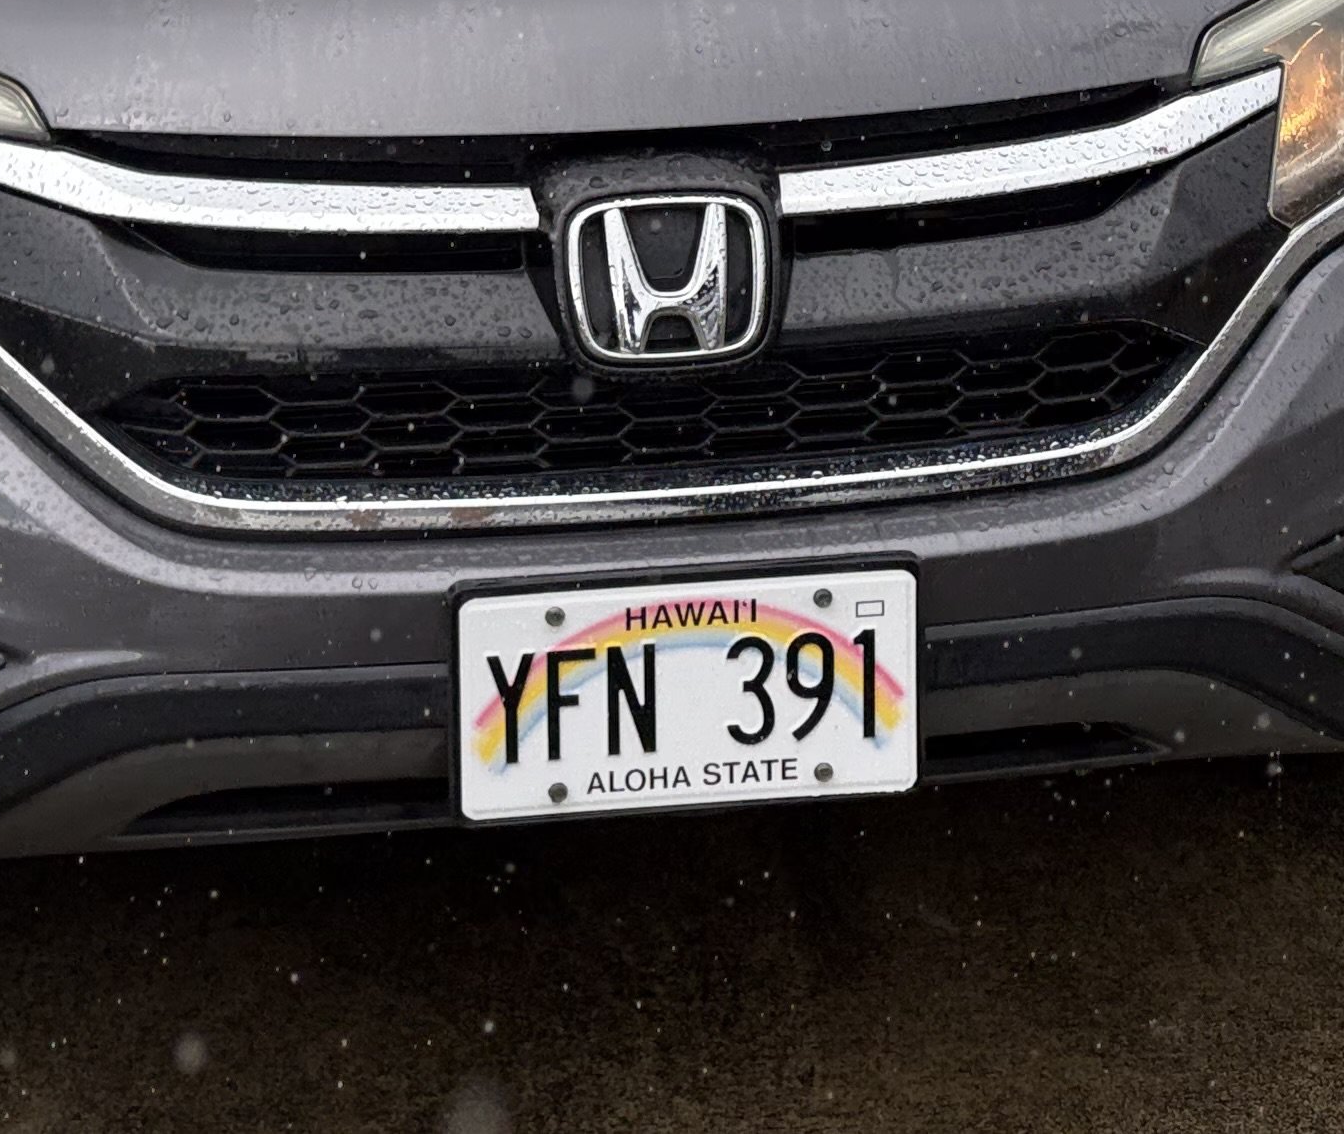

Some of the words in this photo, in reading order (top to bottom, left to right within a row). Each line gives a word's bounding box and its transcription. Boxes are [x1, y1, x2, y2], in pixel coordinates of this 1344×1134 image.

[486, 643, 657, 764] YFN
[726, 629, 876, 746] 391
[586, 767, 691, 795] ALOHA
[703, 758, 799, 786] STATE
